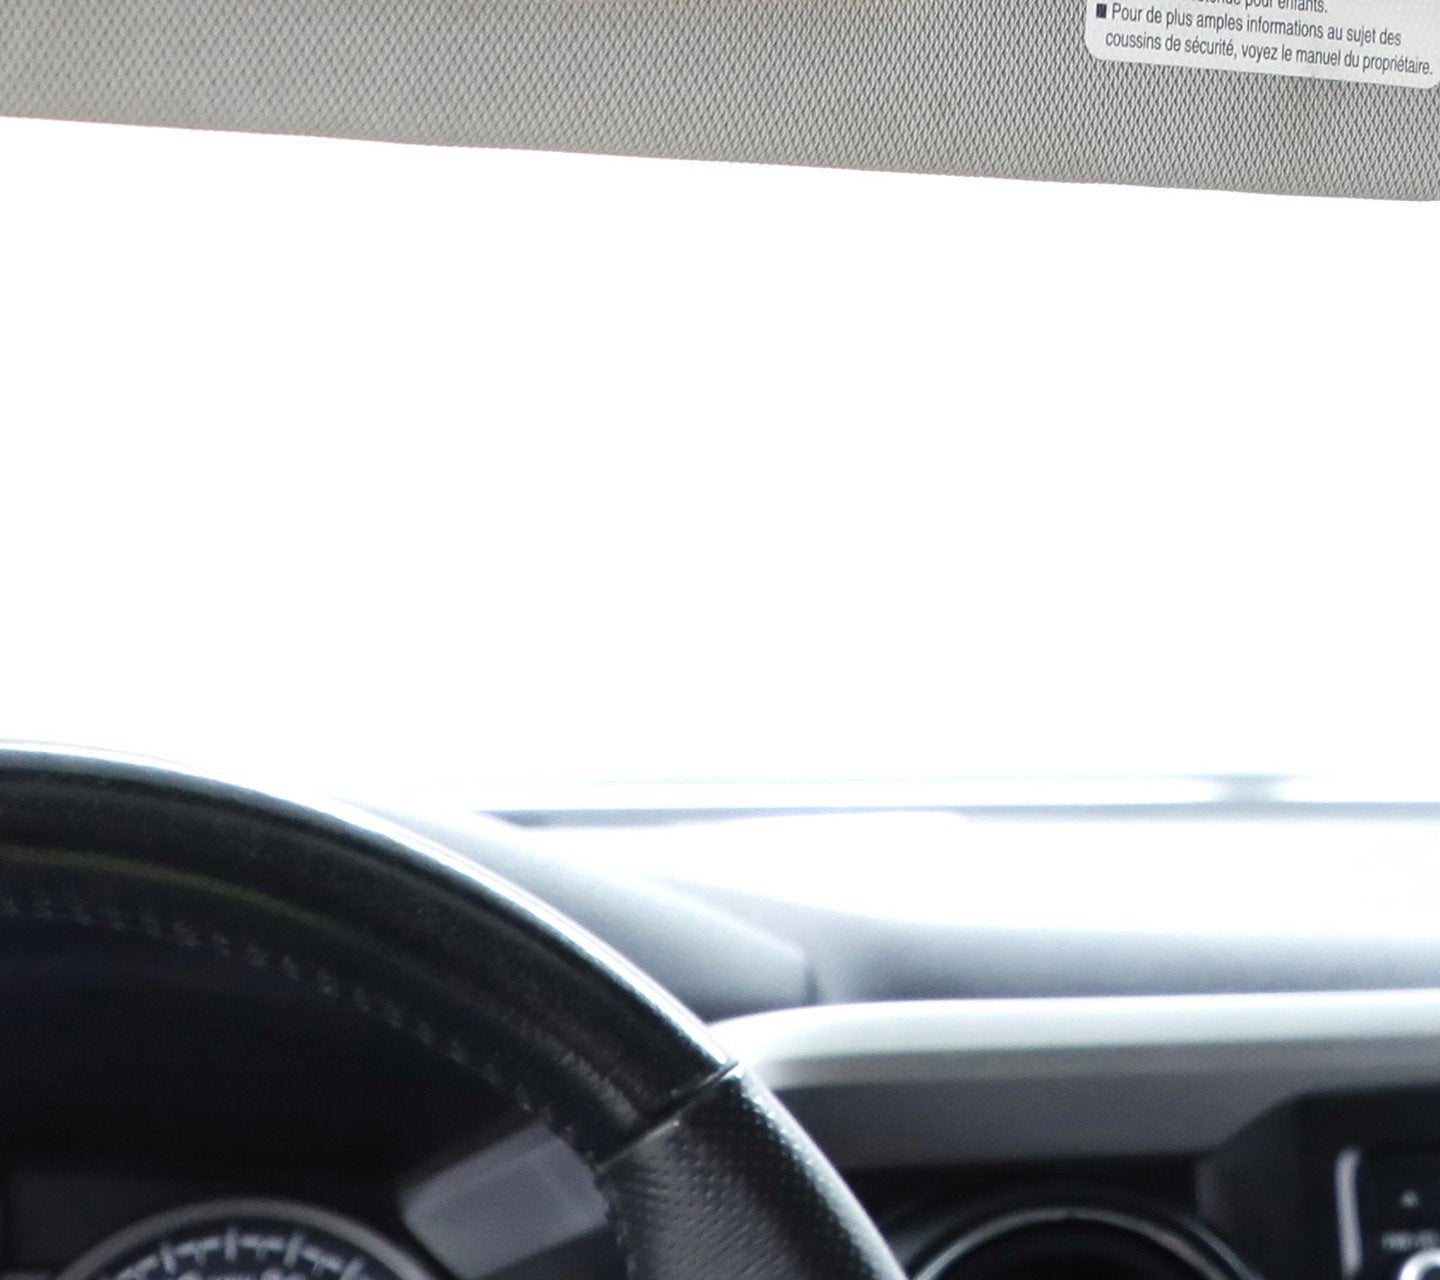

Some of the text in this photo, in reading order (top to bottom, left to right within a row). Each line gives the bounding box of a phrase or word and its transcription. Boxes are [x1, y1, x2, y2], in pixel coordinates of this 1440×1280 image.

[1111, 2, 1402, 47] Pour de plus amples informations au sujet des
[1105, 31, 1434, 76] coussins de sécurité, voyez le manuel du propriétaire.
